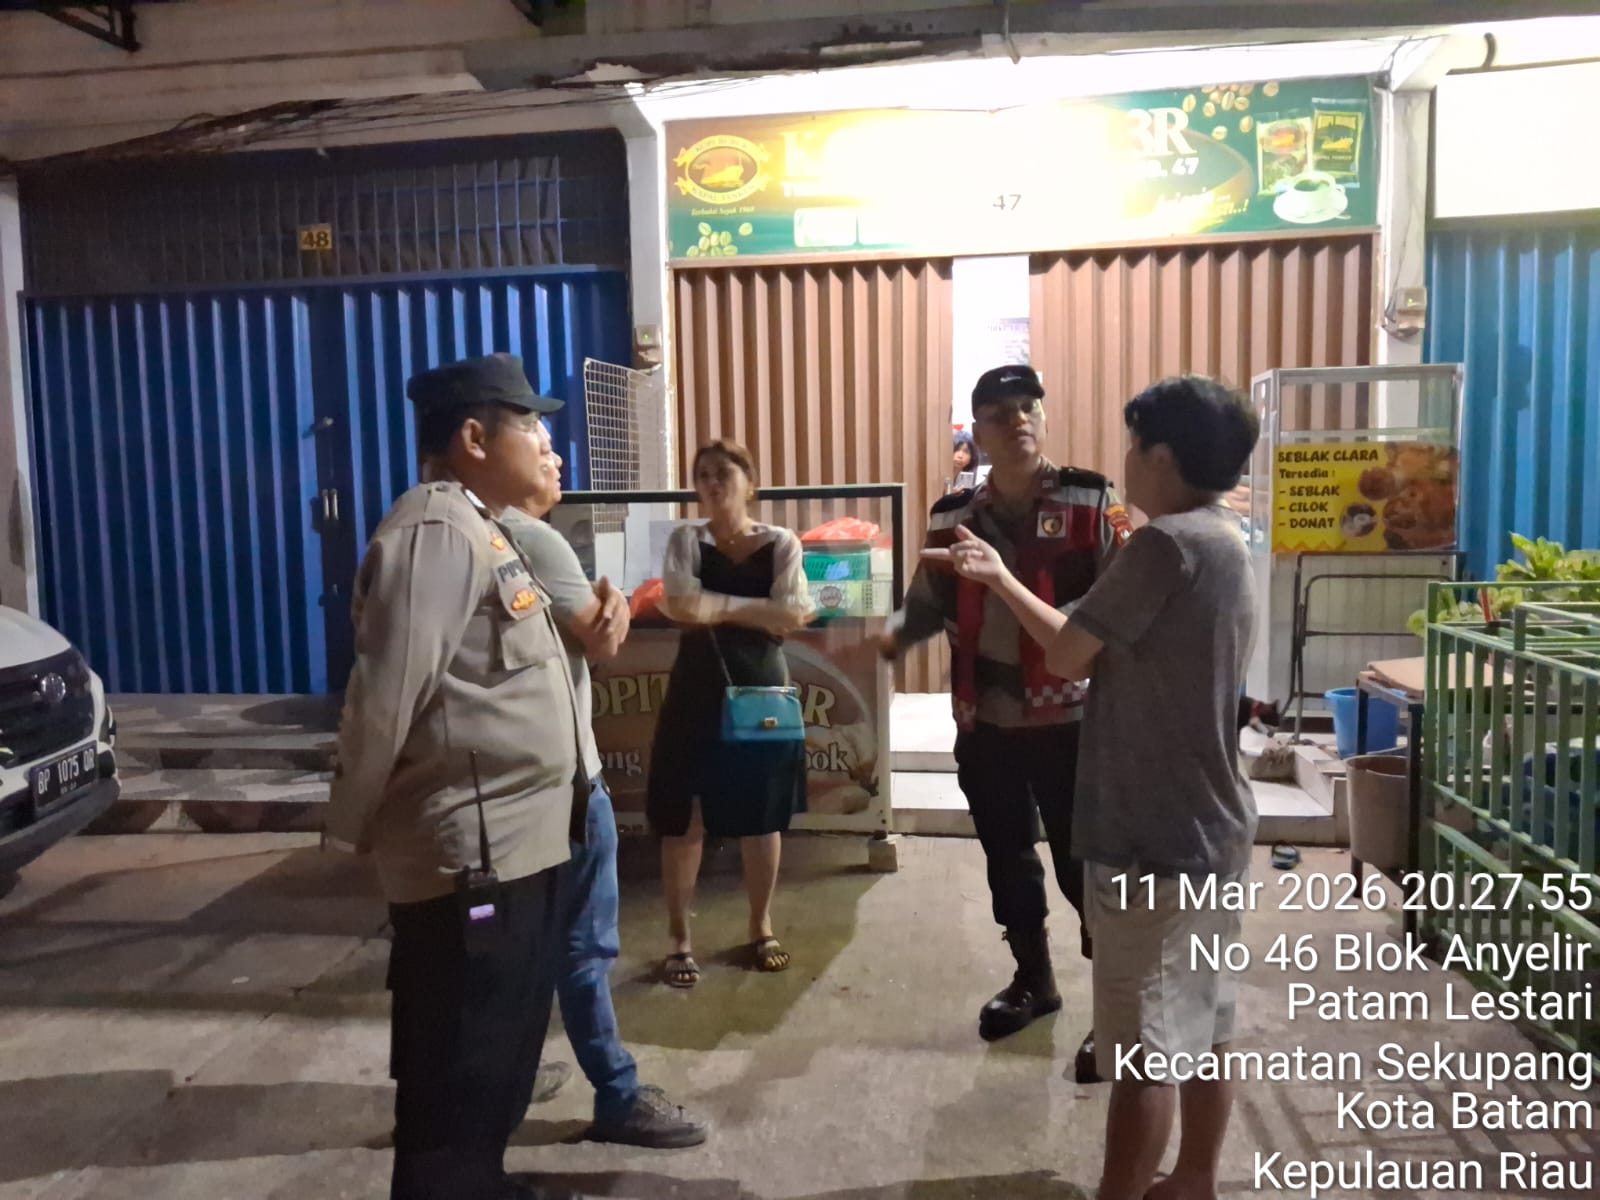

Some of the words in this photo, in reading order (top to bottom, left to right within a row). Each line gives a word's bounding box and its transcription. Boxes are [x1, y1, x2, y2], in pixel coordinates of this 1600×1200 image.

[1171, 157, 1199, 175] 47
[992, 194, 1021, 210] 47
[303, 230, 329, 248] 48
[1278, 451, 1329, 463] SEBLAK
[1333, 449, 1379, 462] CLARA
[1279, 468, 1329, 479] Tersedia
[1289, 485, 1340, 497] SEBLAK
[1289, 501, 1329, 513] CILOK
[1289, 517, 1335, 529] DONAT
[38, 768, 50, 794] BP
[57, 754, 79, 784] 1075
